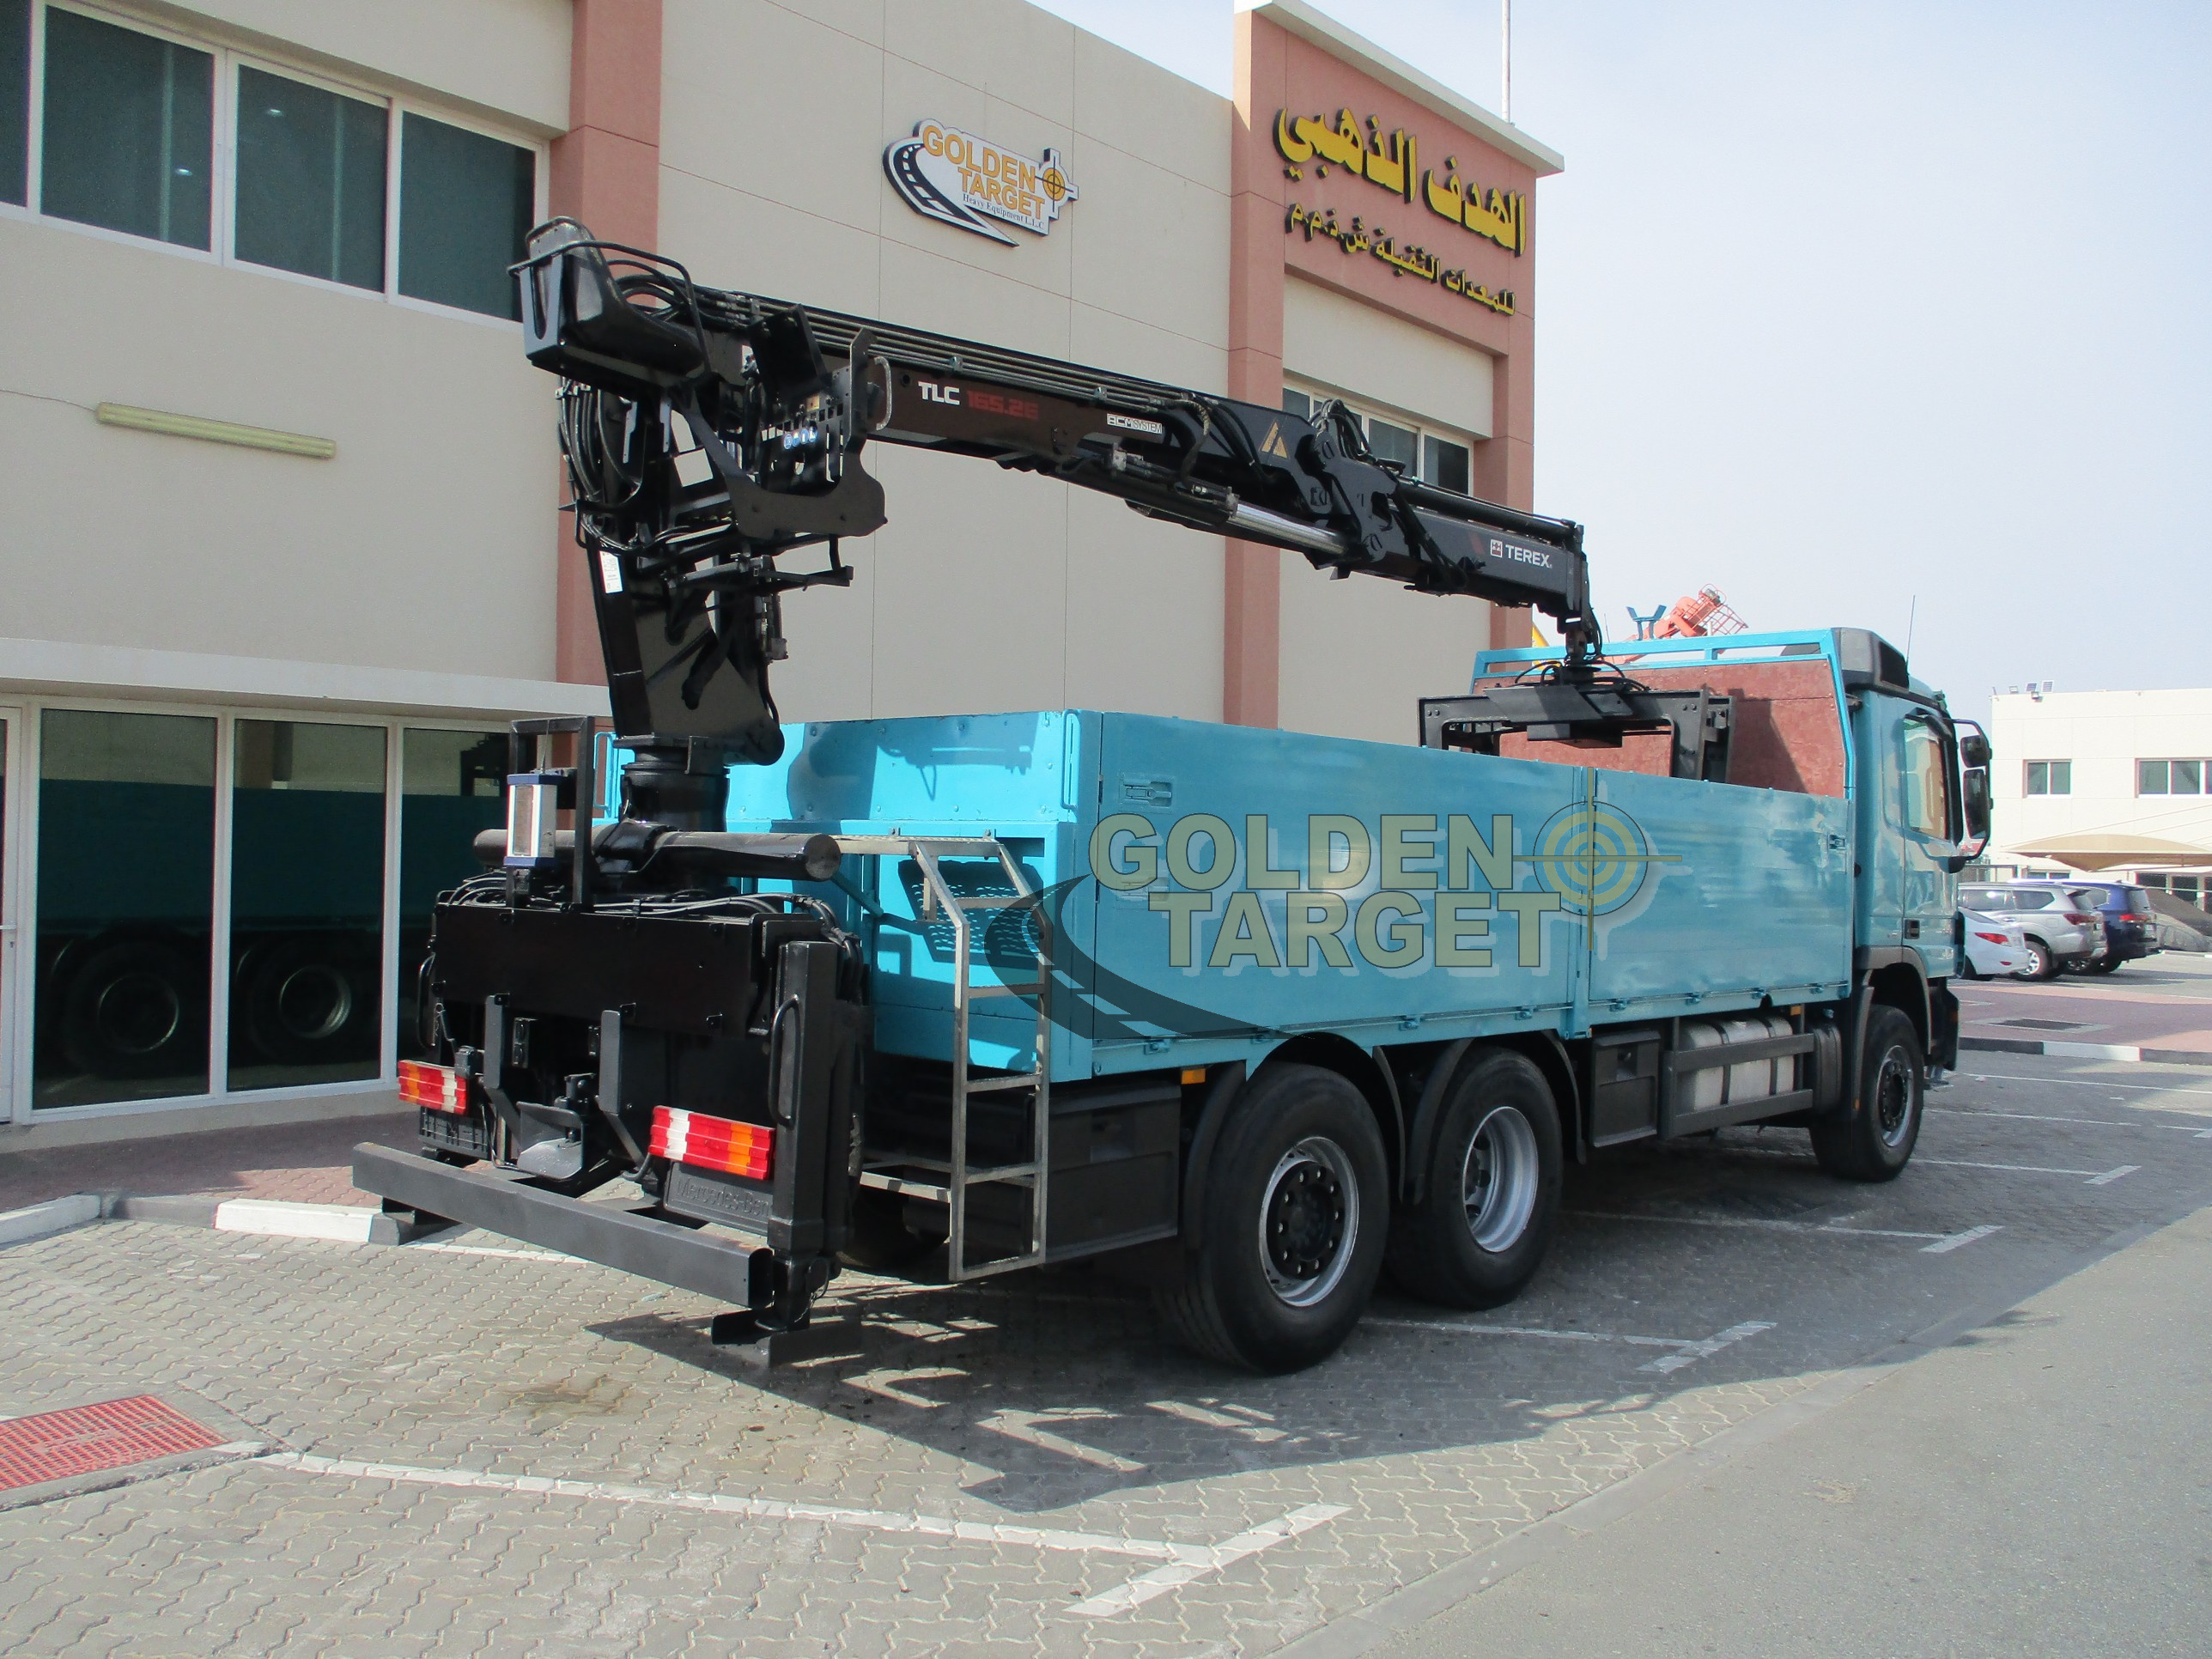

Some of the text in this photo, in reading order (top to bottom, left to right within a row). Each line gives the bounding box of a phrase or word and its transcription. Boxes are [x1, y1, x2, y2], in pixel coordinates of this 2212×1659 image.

[922, 125, 1036, 194] GOLDEN
[957, 166, 1045, 220] TARGET
[1273, 108, 1526, 257] الهدف الذهبي
[963, 193, 984, 210] Heavy
[987, 203, 1024, 223] Equipment
[1441, 268, 1516, 316] للمعدات
[917, 380, 961, 406] TLC
[1133, 418, 1162, 434] SYSTEM
[1504, 544, 1551, 568] TEREX
[677, 1177, 772, 1218] Mercedes-Ben
